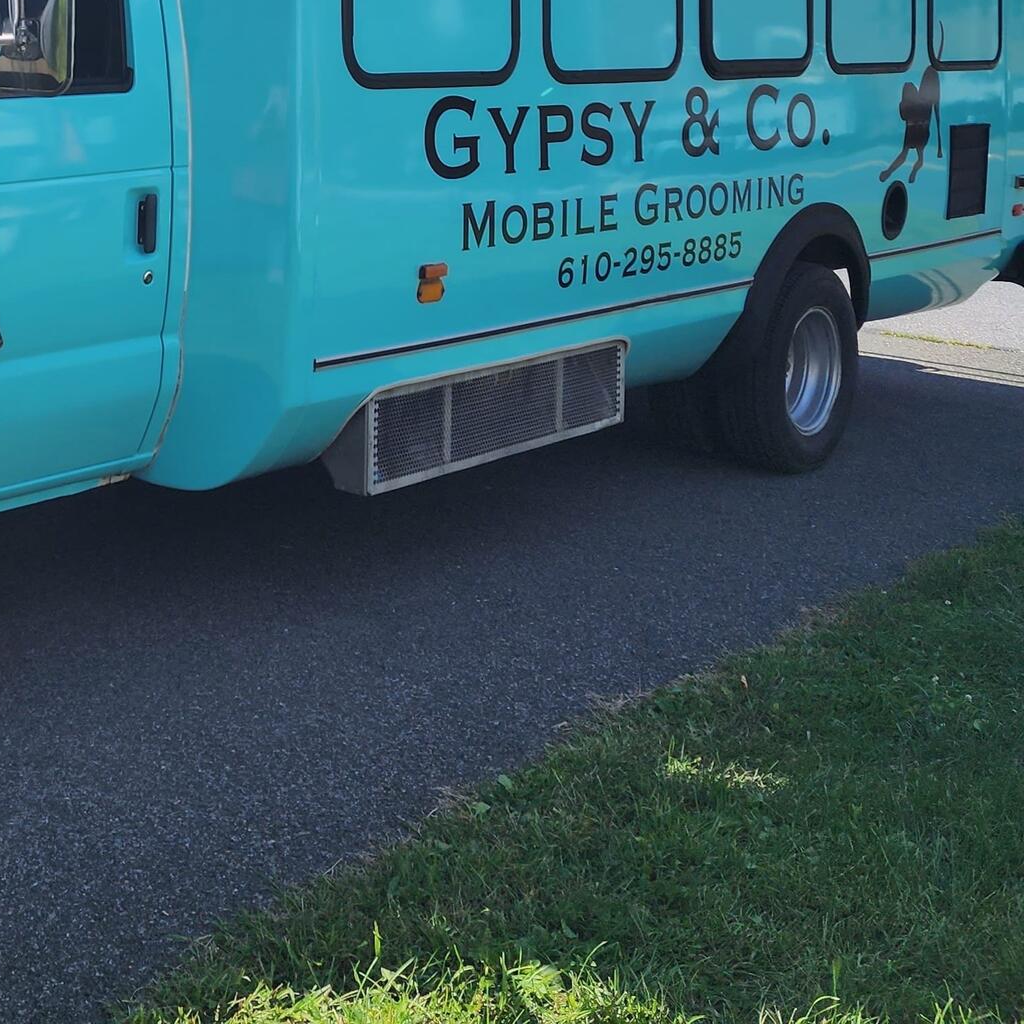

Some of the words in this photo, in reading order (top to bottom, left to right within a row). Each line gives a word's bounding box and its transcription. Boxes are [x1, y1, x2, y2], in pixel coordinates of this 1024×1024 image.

[424, 95, 657, 179] GYPSY
[681, 86, 720, 158] &
[746, 83, 830, 152] CO.
[461, 193, 618, 251] MOBILE
[634, 173, 805, 226] GROOMING
[558, 231, 742, 288] 610-295-8885
